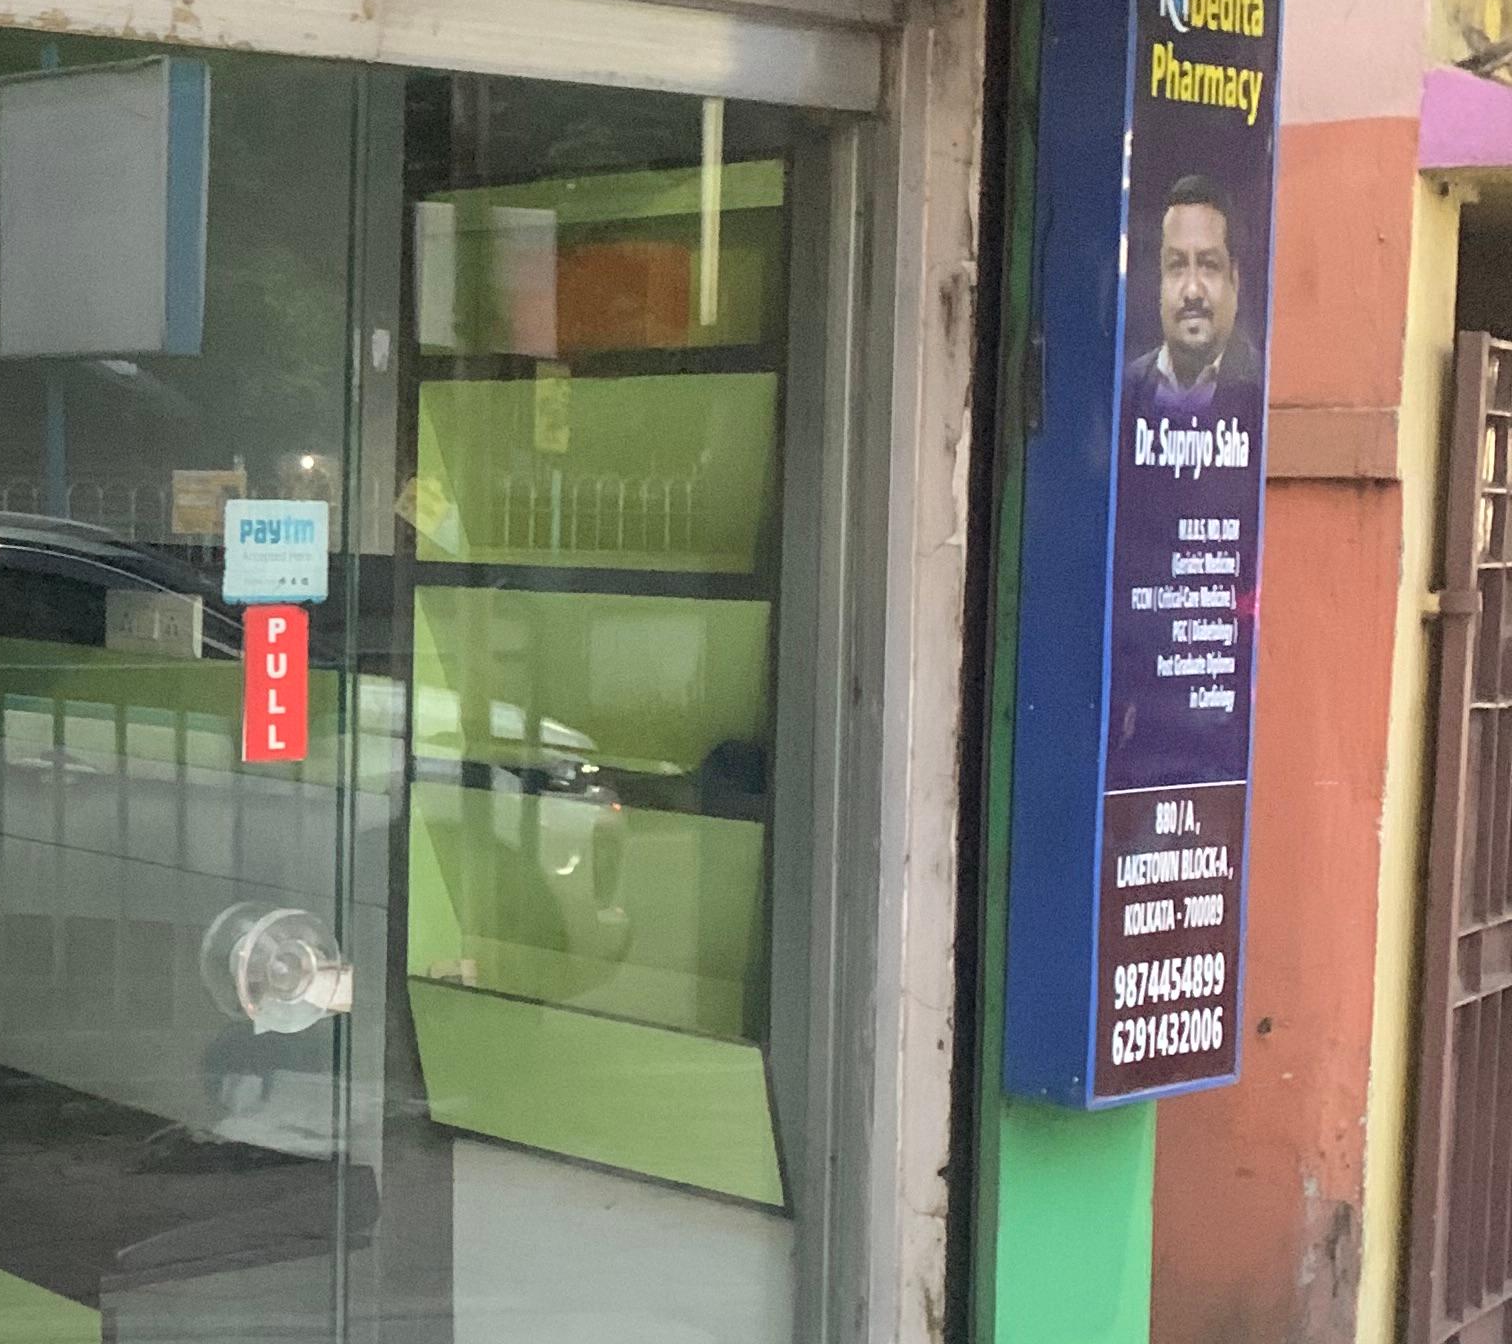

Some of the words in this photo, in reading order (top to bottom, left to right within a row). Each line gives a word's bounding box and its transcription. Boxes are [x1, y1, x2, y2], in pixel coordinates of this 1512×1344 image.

[1151, 42, 1263, 125] Pharmacy
[1159, 416, 1213, 480] Supriyo
[1216, 417, 1250, 468] Saha
[266, 617, 287, 750] PULL
[1116, 850, 1180, 889] LAKETOWN
[1124, 899, 1175, 937] KOLKATA
[1183, 893, 1224, 929] 700089
[1114, 952, 1226, 1010] 9874454899
[1112, 1007, 1224, 1066] 6291432006
